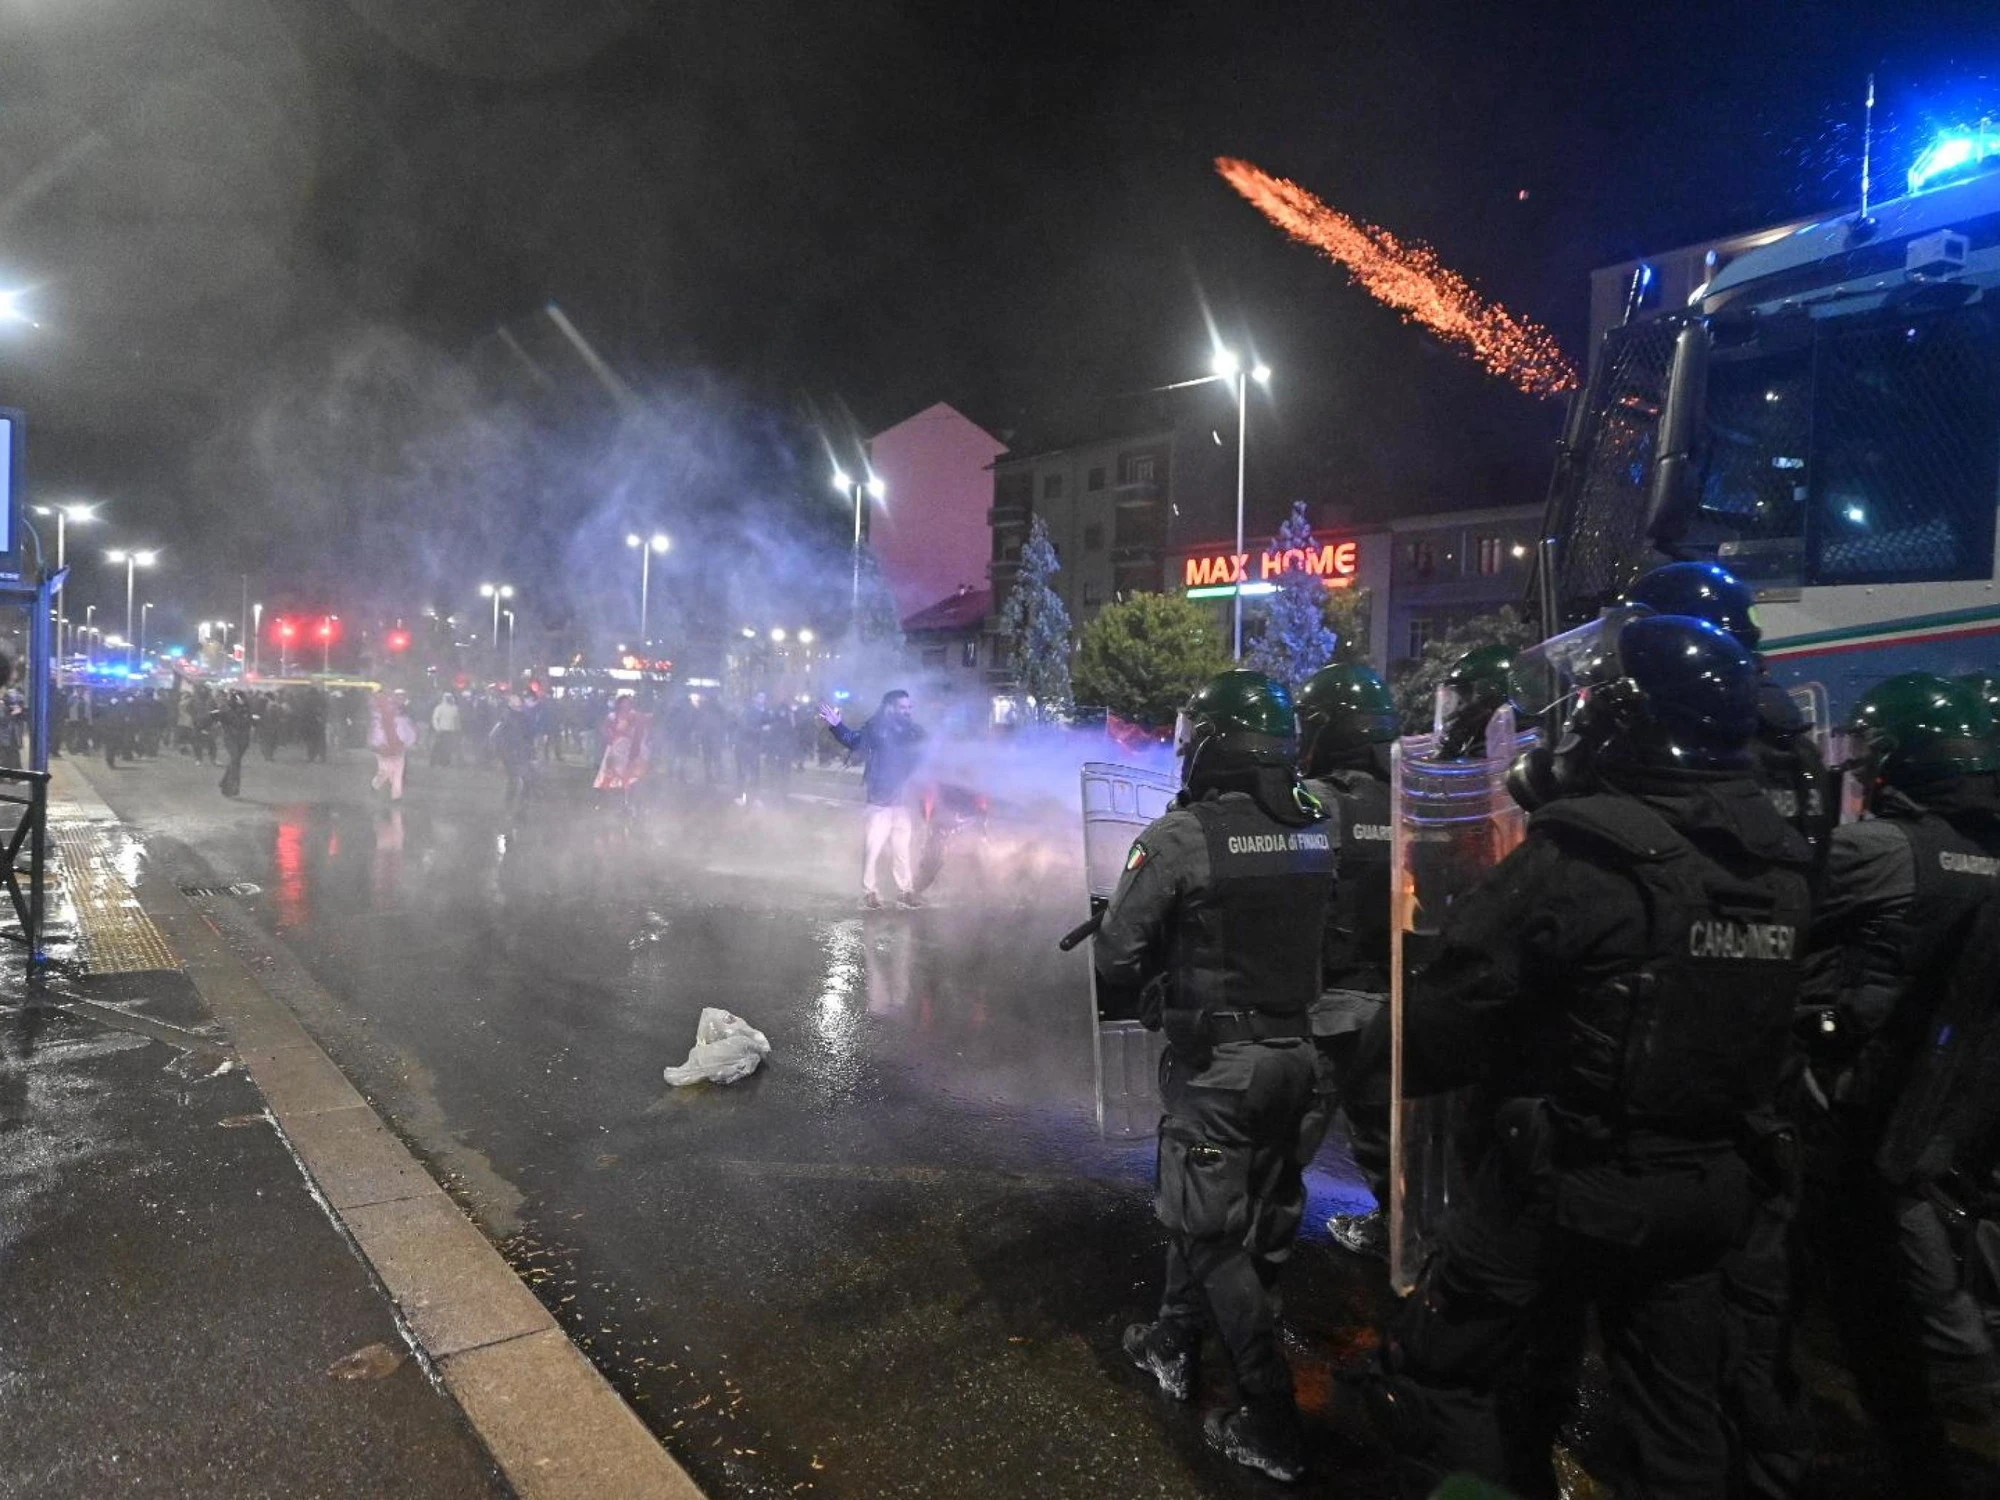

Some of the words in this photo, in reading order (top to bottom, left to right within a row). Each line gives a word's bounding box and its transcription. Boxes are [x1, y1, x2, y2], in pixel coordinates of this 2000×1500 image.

[1186, 553, 1249, 586] MAX
[1261, 542, 1357, 580] HOME
[1228, 834, 1288, 854] GUARDIA
